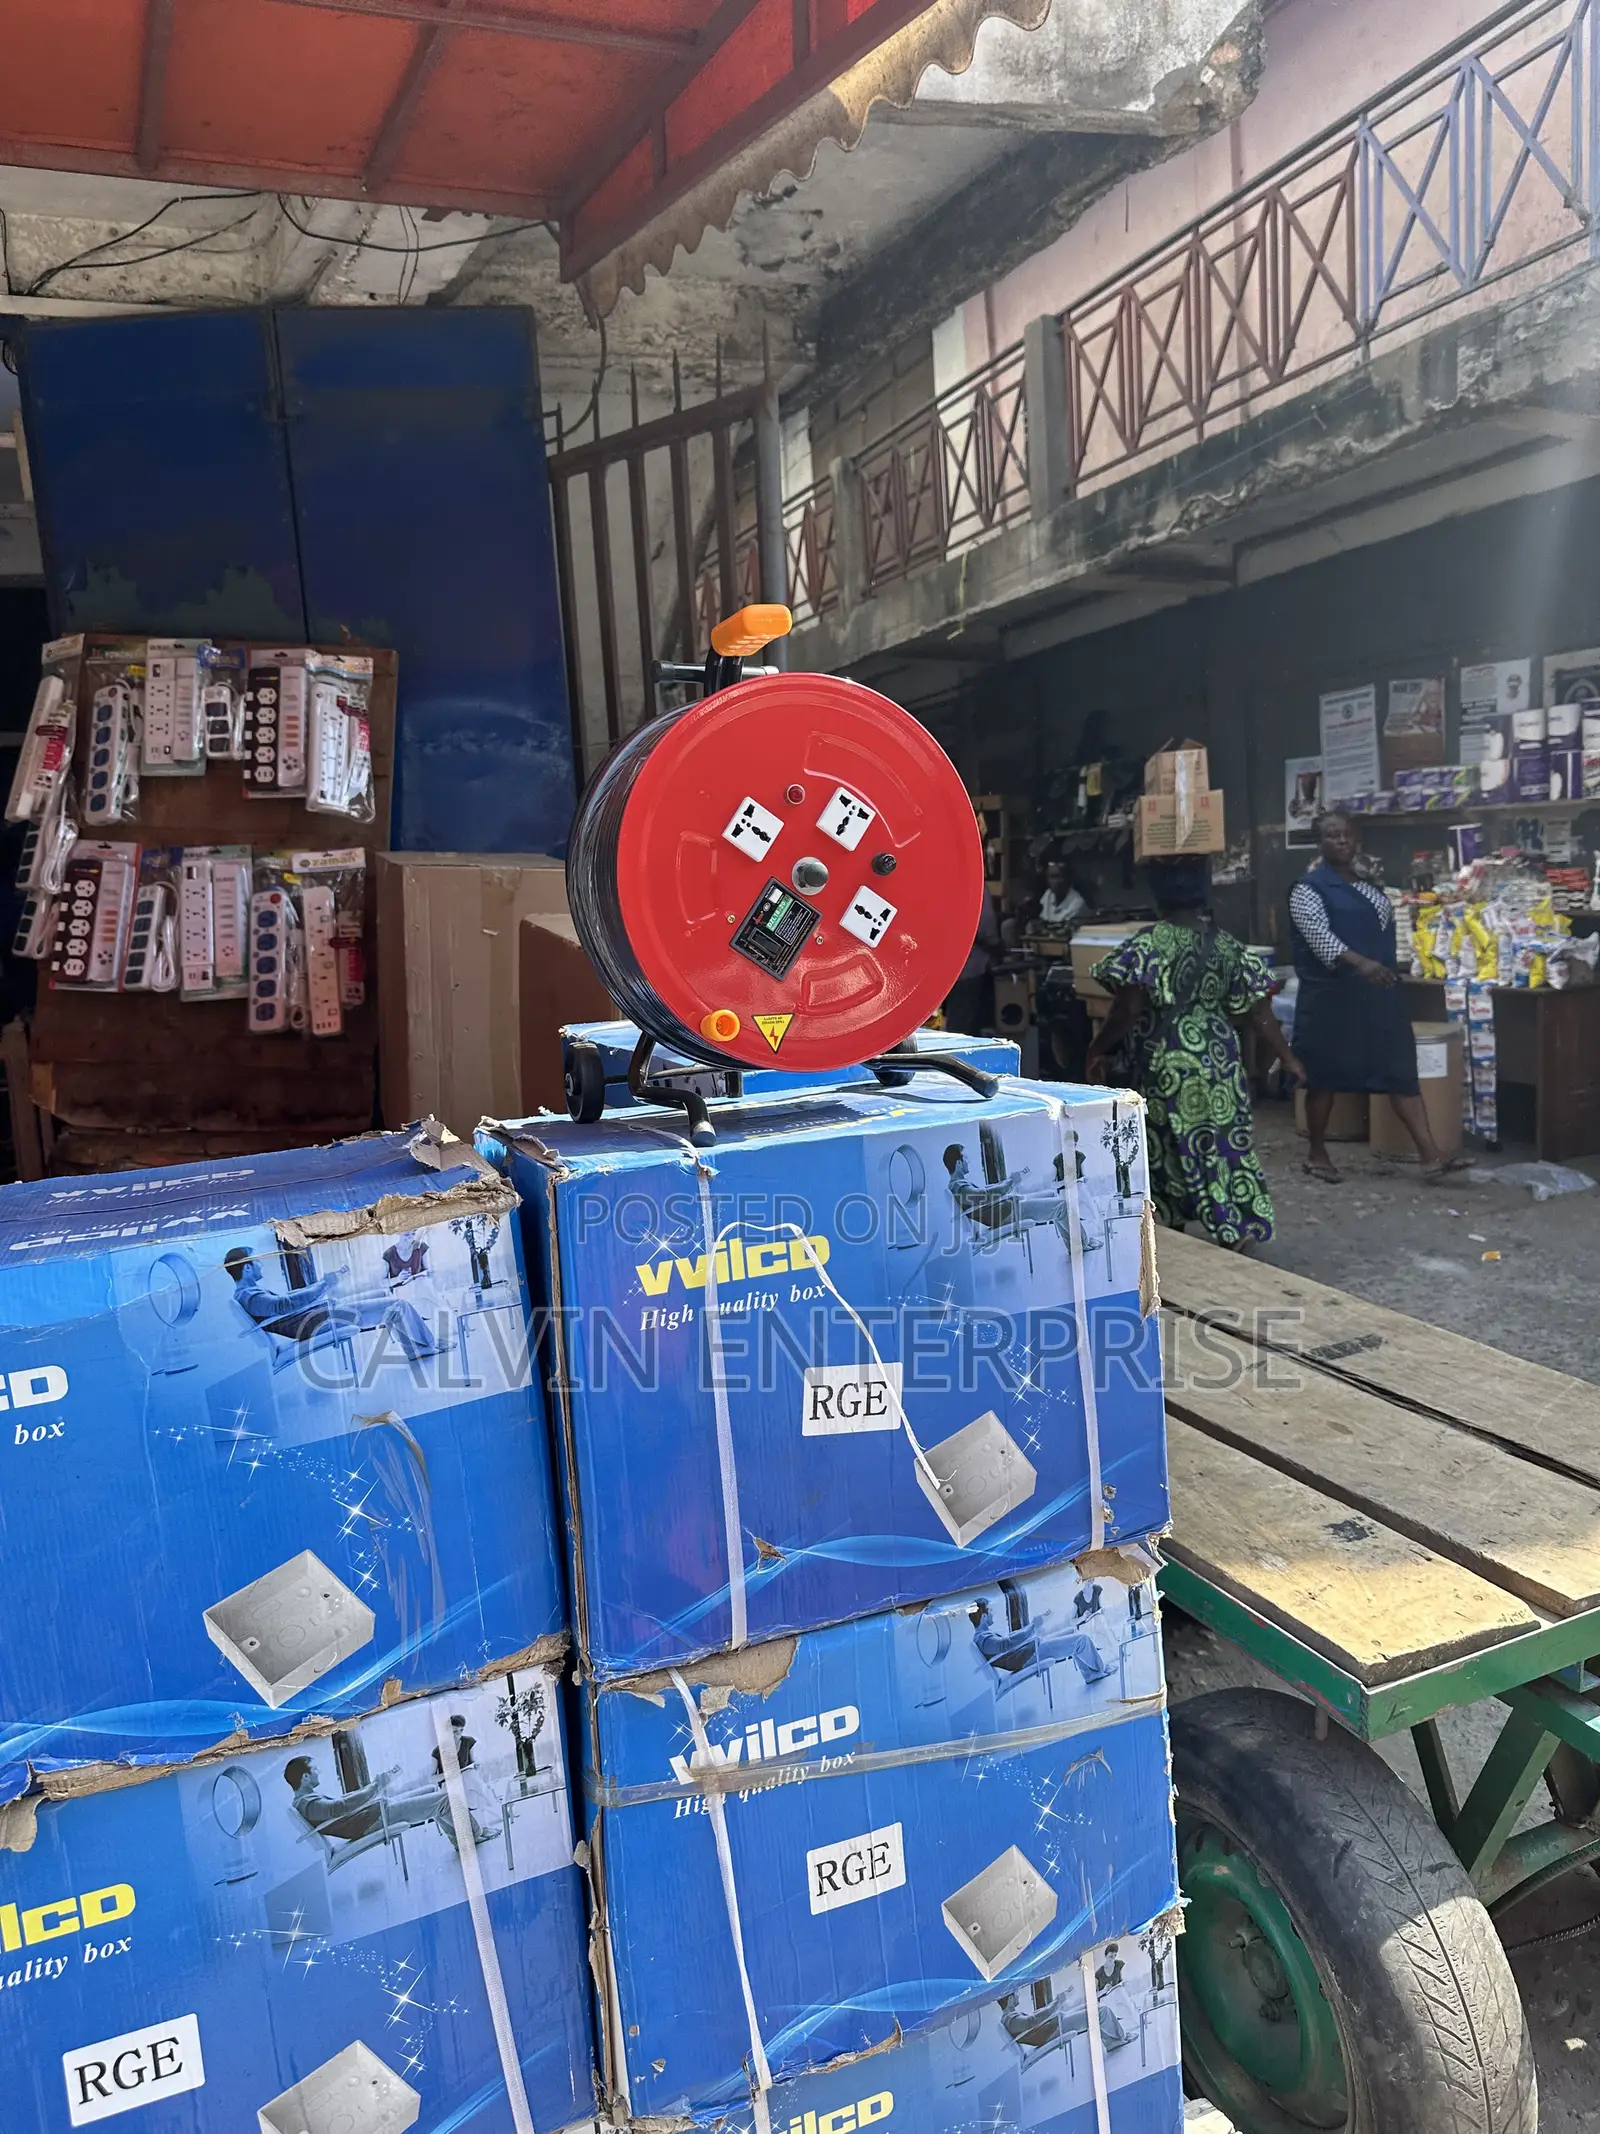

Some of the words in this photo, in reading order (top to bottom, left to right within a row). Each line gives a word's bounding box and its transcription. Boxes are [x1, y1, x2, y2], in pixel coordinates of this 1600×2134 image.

[640, 1304, 695, 1332] High
[716, 1291, 779, 1316] uality
[789, 1283, 828, 1304] box
[809, 1379, 890, 1422] RGE
[14, 1421, 66, 1446] box
[739, 1765, 810, 1804] quality
[820, 1751, 857, 1774] box
[814, 1841, 893, 1898] RGE
[84, 1936, 132, 1964] box
[74, 2036, 184, 2106] RGE
